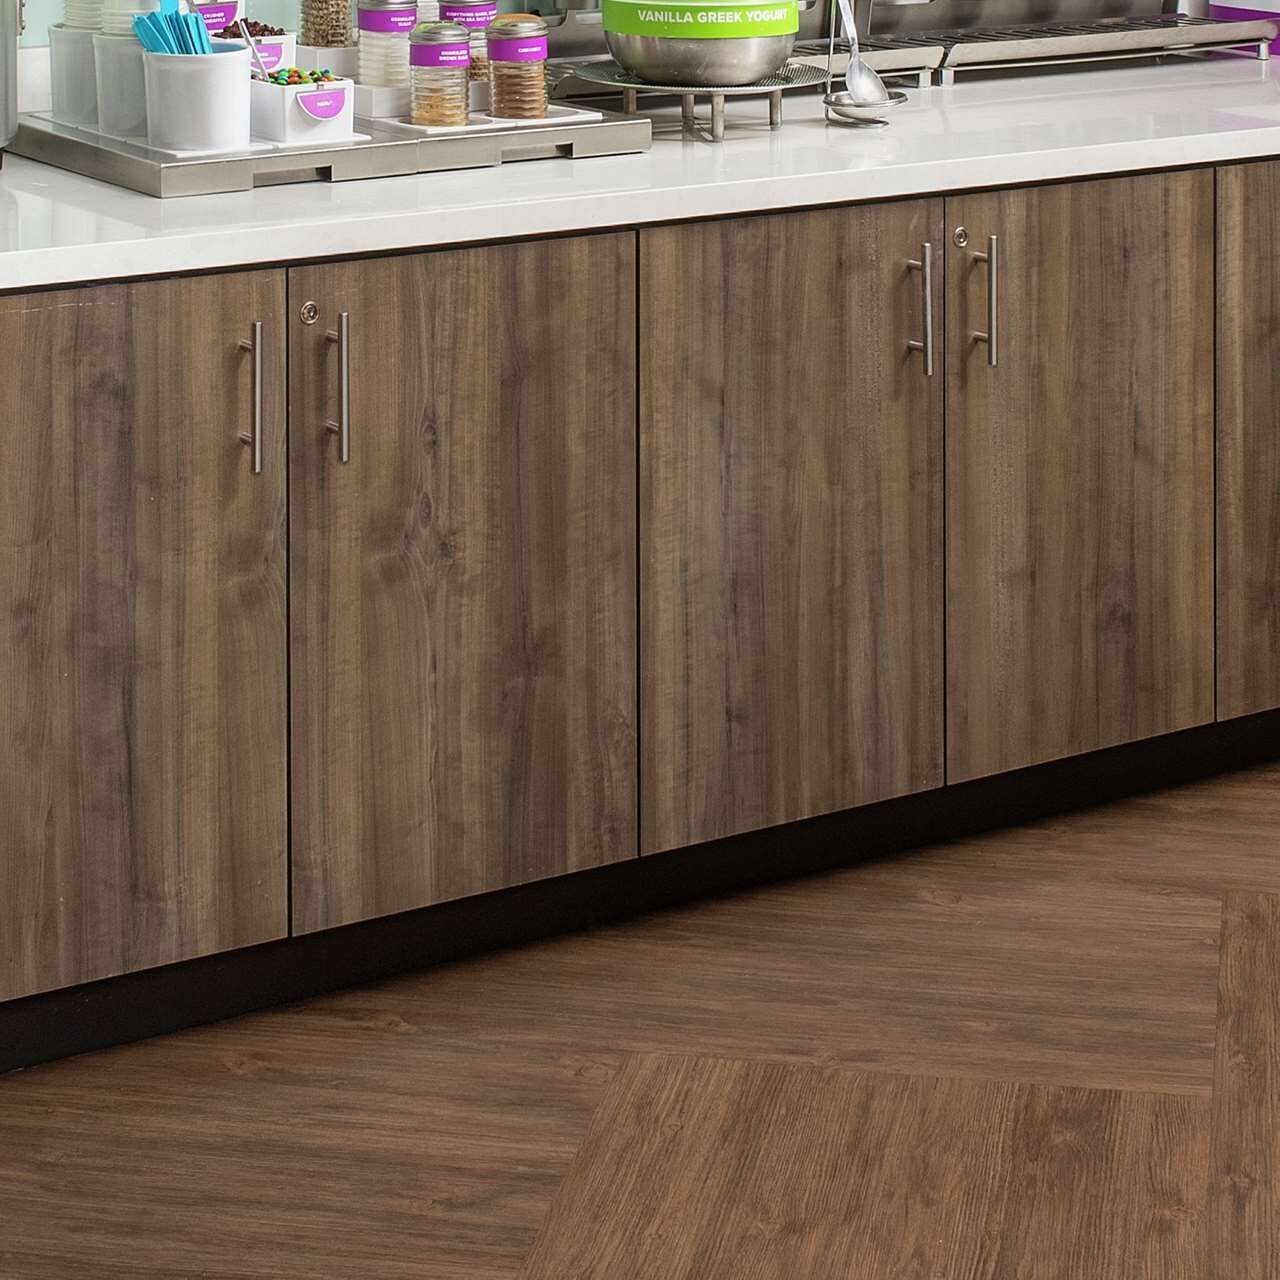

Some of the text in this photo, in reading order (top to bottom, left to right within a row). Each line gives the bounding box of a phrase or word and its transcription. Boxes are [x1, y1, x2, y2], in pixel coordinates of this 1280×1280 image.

[638, 8, 787, 23] VANILLA GREEK YOGURT
